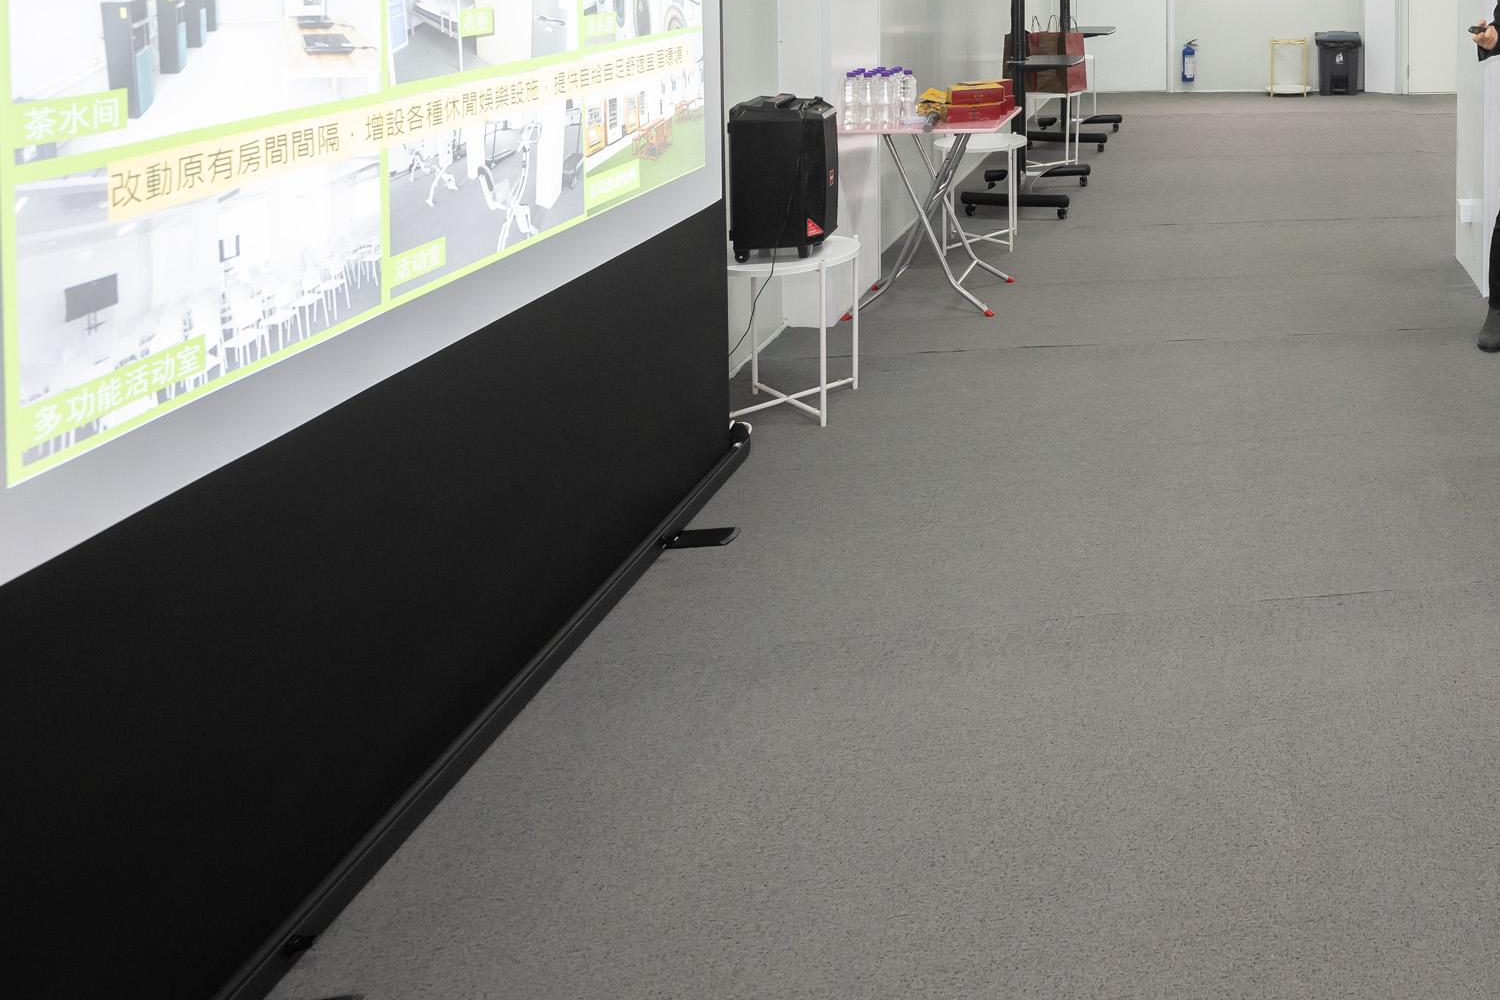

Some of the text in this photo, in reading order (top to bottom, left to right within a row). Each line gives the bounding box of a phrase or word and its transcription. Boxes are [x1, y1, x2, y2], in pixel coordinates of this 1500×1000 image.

[24, 97, 120, 141] 茶水间
[33, 345, 200, 442] 多功能活动室
